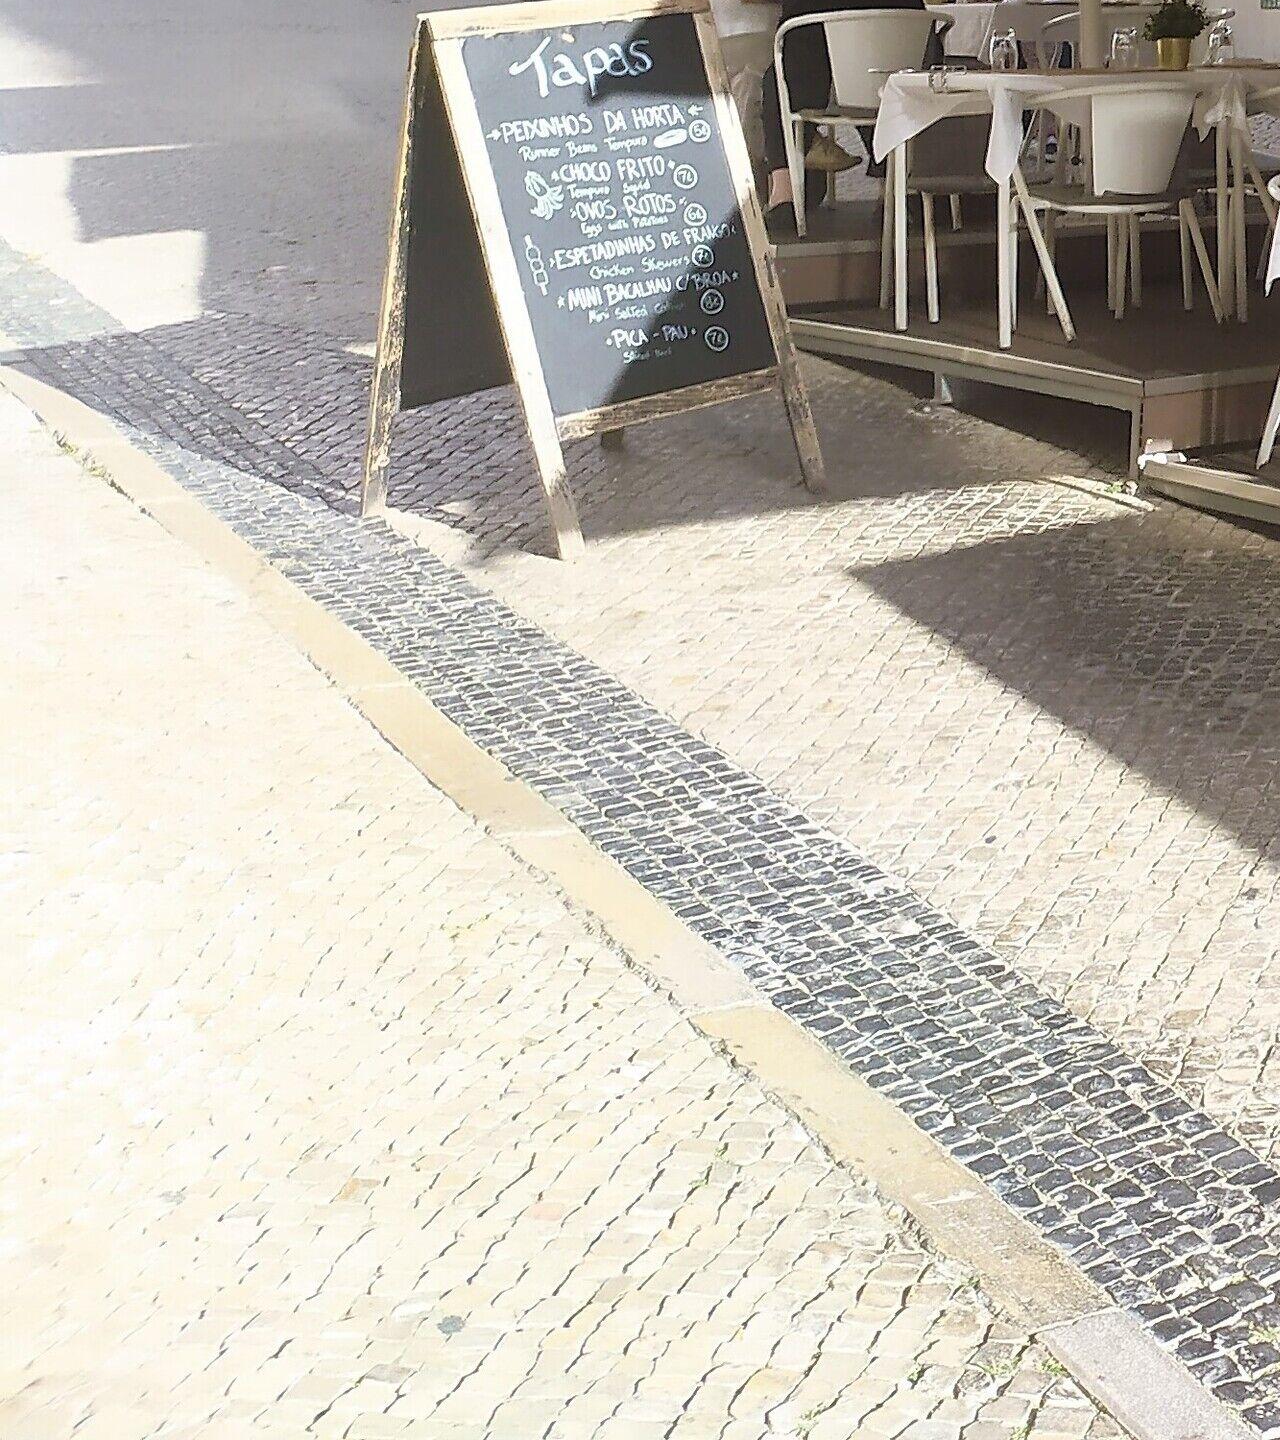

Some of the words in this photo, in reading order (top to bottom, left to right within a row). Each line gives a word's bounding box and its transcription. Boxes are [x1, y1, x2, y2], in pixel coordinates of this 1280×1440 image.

[500, 112, 593, 144] PEIXINHOS
[603, 110, 628, 134] DA
[631, 104, 686, 130] HORTA
[559, 160, 611, 183] CHOCO
[616, 155, 666, 181] FRITO
[574, 199, 618, 221] OVOS
[622, 192, 677, 218] ROTOS
[554, 233, 656, 270] ESPETADINHAS
[660, 232, 681, 250] DE
[568, 286, 603, 311] MINI
[603, 277, 672, 306] BACALHAU
